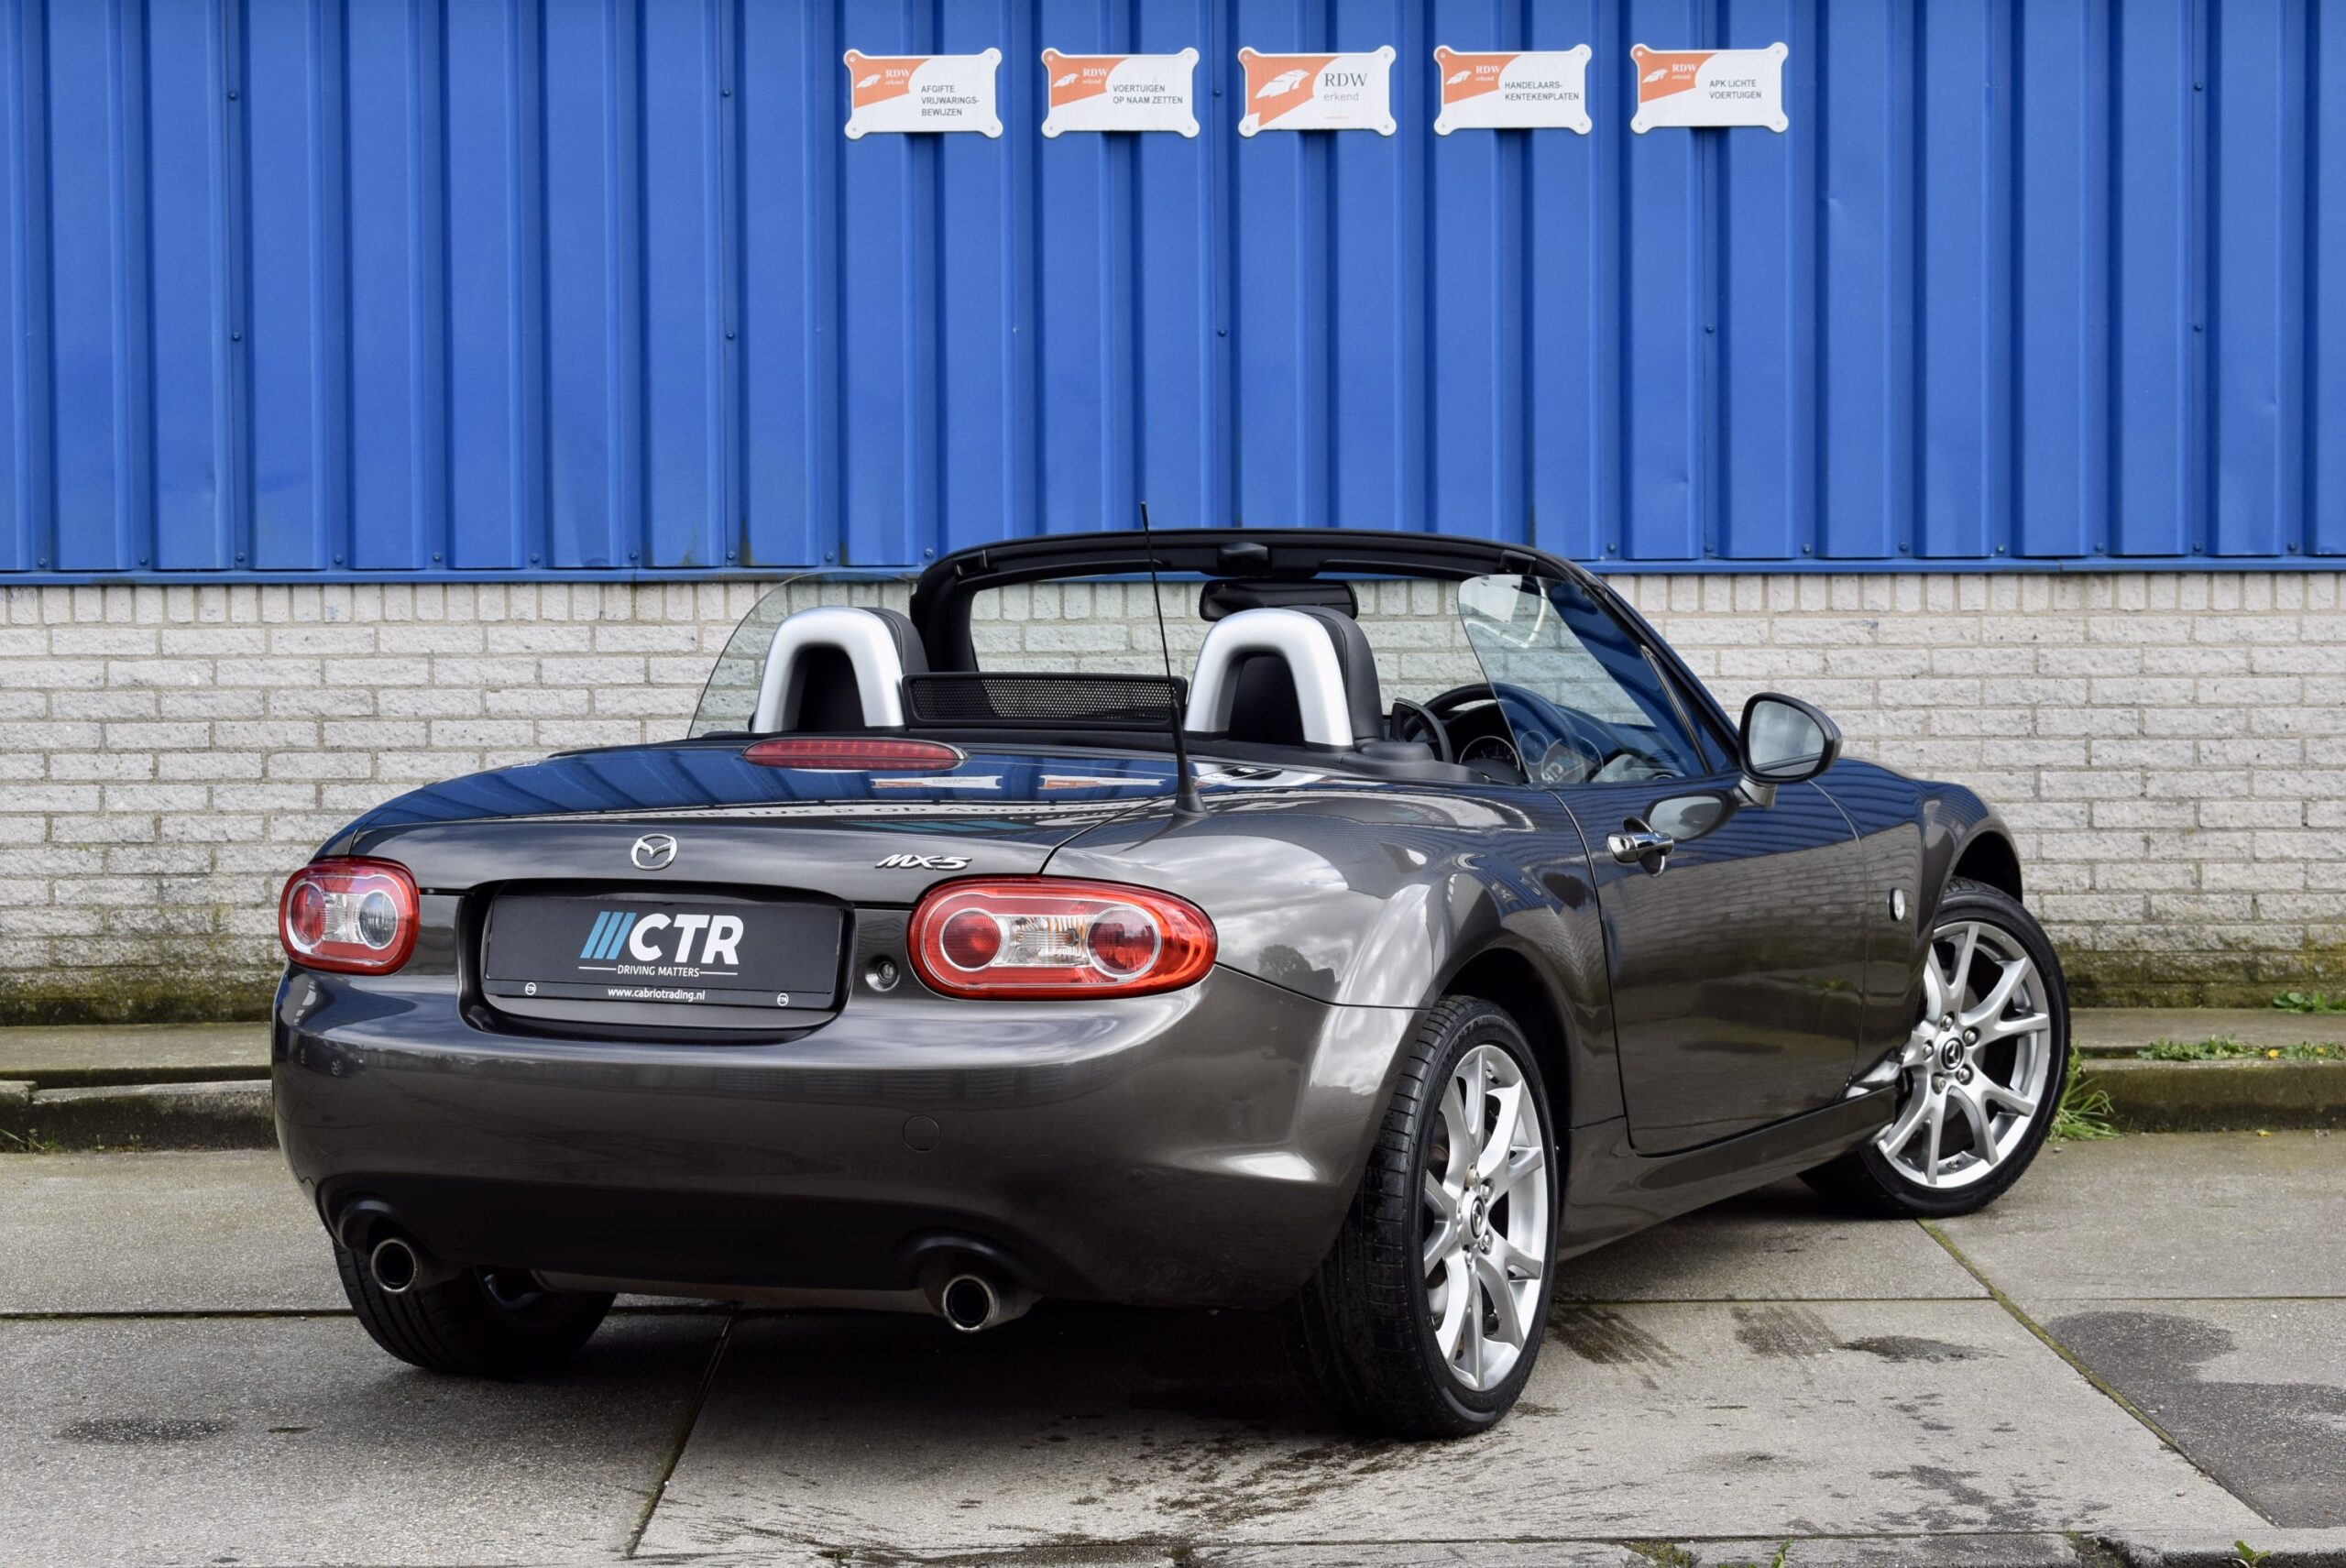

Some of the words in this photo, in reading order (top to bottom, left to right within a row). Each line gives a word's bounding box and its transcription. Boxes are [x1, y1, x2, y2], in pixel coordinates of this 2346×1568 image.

[1475, 65, 1501, 74] RDW
[1672, 64, 1697, 72] RDW
[885, 69, 910, 77] RDW
[1082, 68, 1107, 77] RDW
[1325, 72, 1367, 87] RDW
[1728, 79, 1757, 87] LICHTE
[921, 85, 955, 93] AFGIFTE
[1113, 84, 1166, 93] VOERTUIGEN
[1323, 93, 1359, 101] erkend
[1505, 93, 1579, 101] KENTEKENPLATEN
[1709, 91, 1761, 99] VOERTUIGEN
[921, 96, 980, 104] VRIJWARINGS-
[921, 108, 962, 116] BEWIJZEN
[875, 854, 972, 871] MX-5
[630, 913, 744, 965] CTR
[617, 965, 655, 976] DRIVING
[658, 966, 700, 978] MATTERS
[608, 988, 705, 1002] www.cabriotrading.nl
